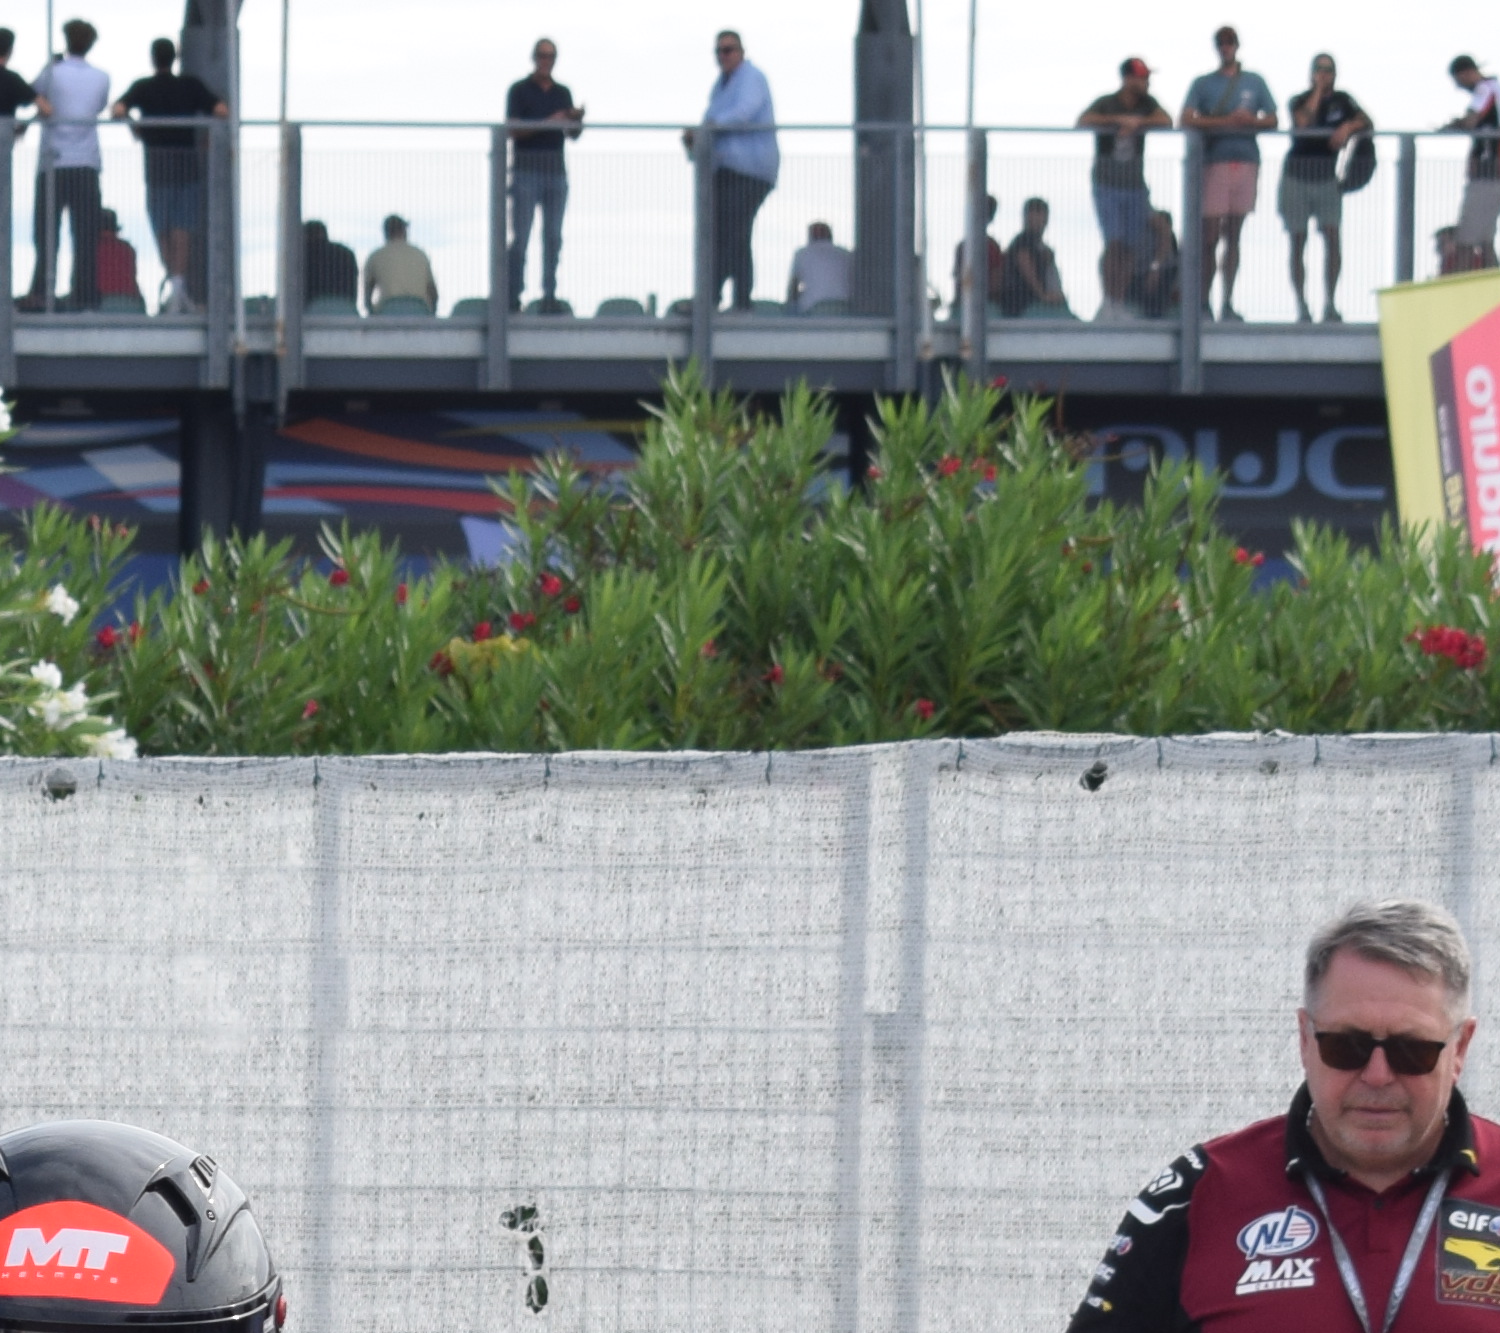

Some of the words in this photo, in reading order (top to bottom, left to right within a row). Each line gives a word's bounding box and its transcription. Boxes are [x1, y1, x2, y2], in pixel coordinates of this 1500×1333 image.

[4, 1228, 130, 1270] MT
[1, 1271, 118, 1284] HELMETS
[1238, 1258, 1316, 1284] MAX
